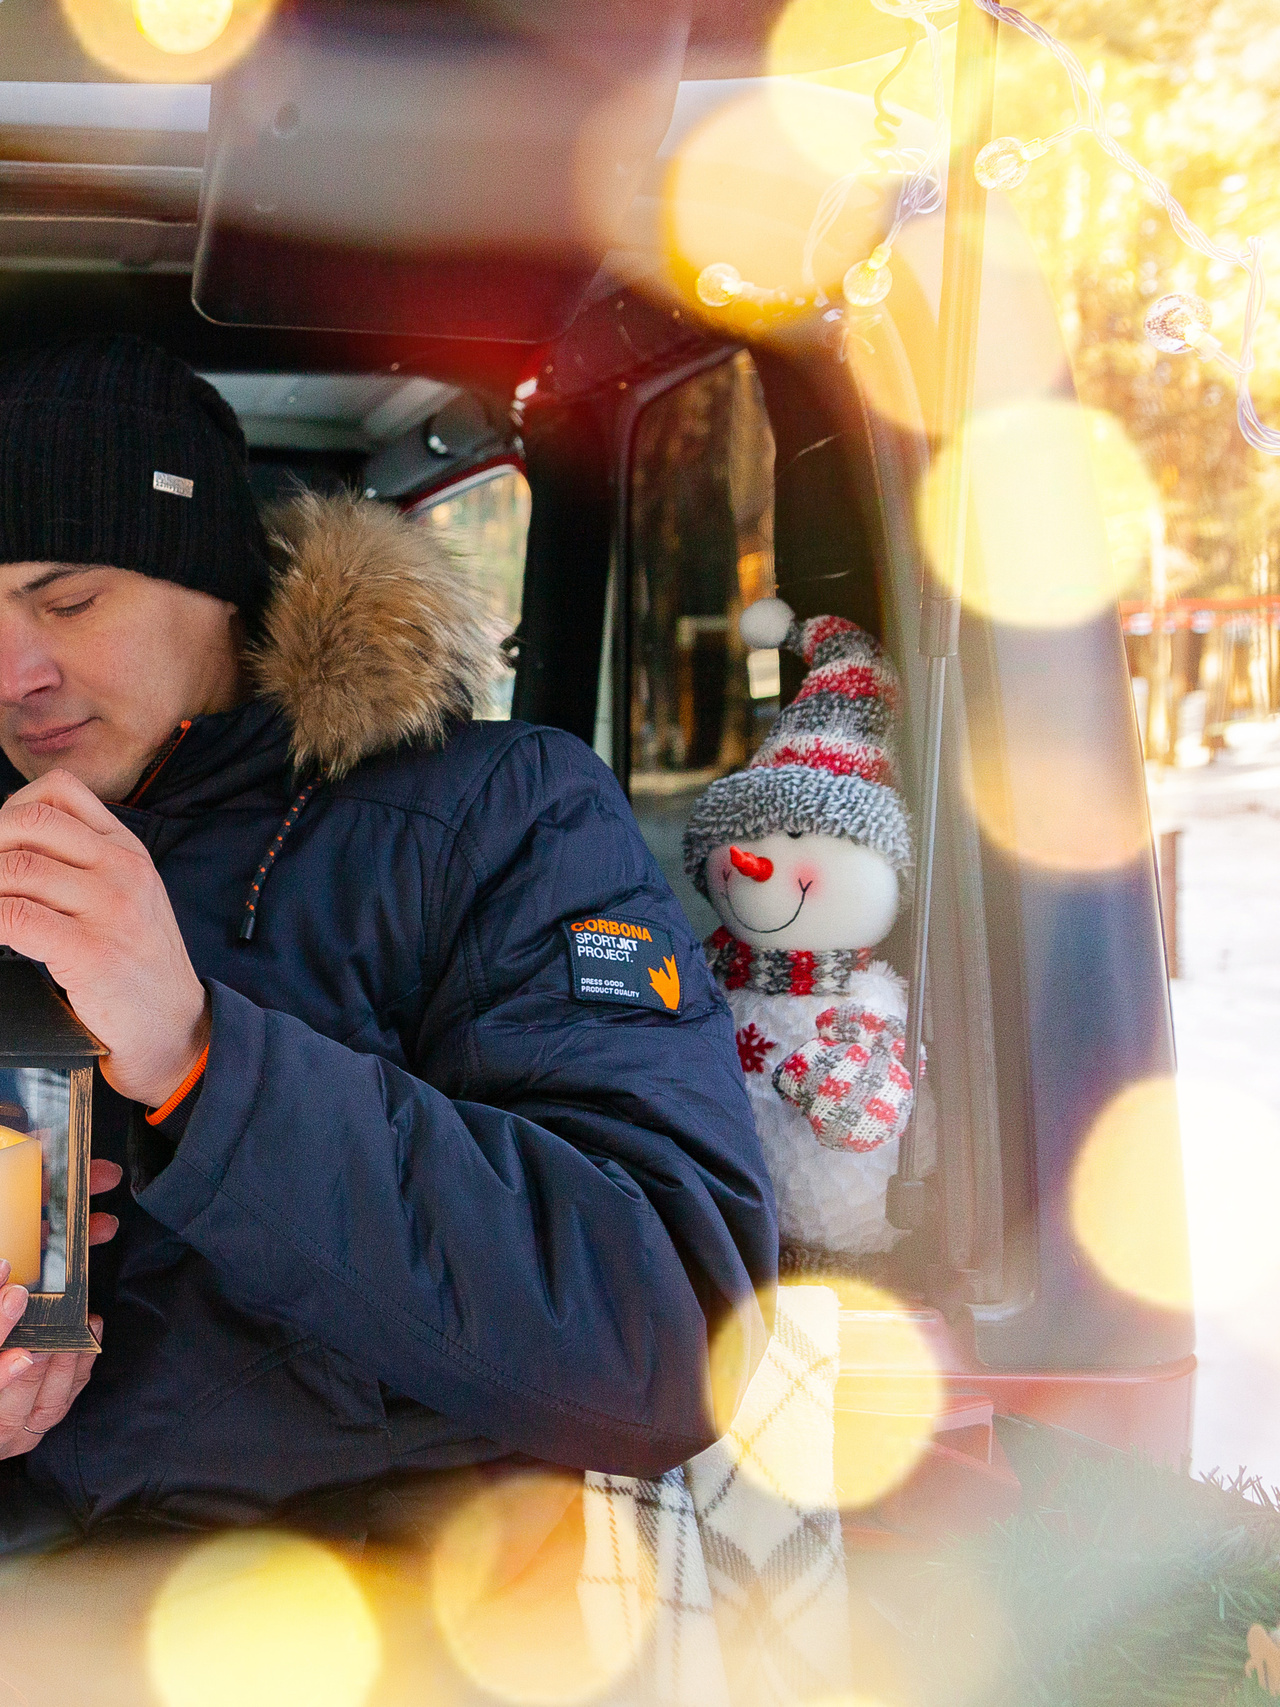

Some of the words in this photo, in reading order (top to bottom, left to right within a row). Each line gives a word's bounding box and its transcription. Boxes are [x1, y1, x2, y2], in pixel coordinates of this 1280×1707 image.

[571, 919, 653, 942] CORBONA
[576, 933, 638, 951] SPORTJKT
[578, 946, 634, 962] PROJECT.
[581, 977, 603, 986] DRESS
[604, 979, 624, 988] GOOD
[581, 986, 613, 995] PRODUCT
[614, 988, 640, 998] QUALITY
